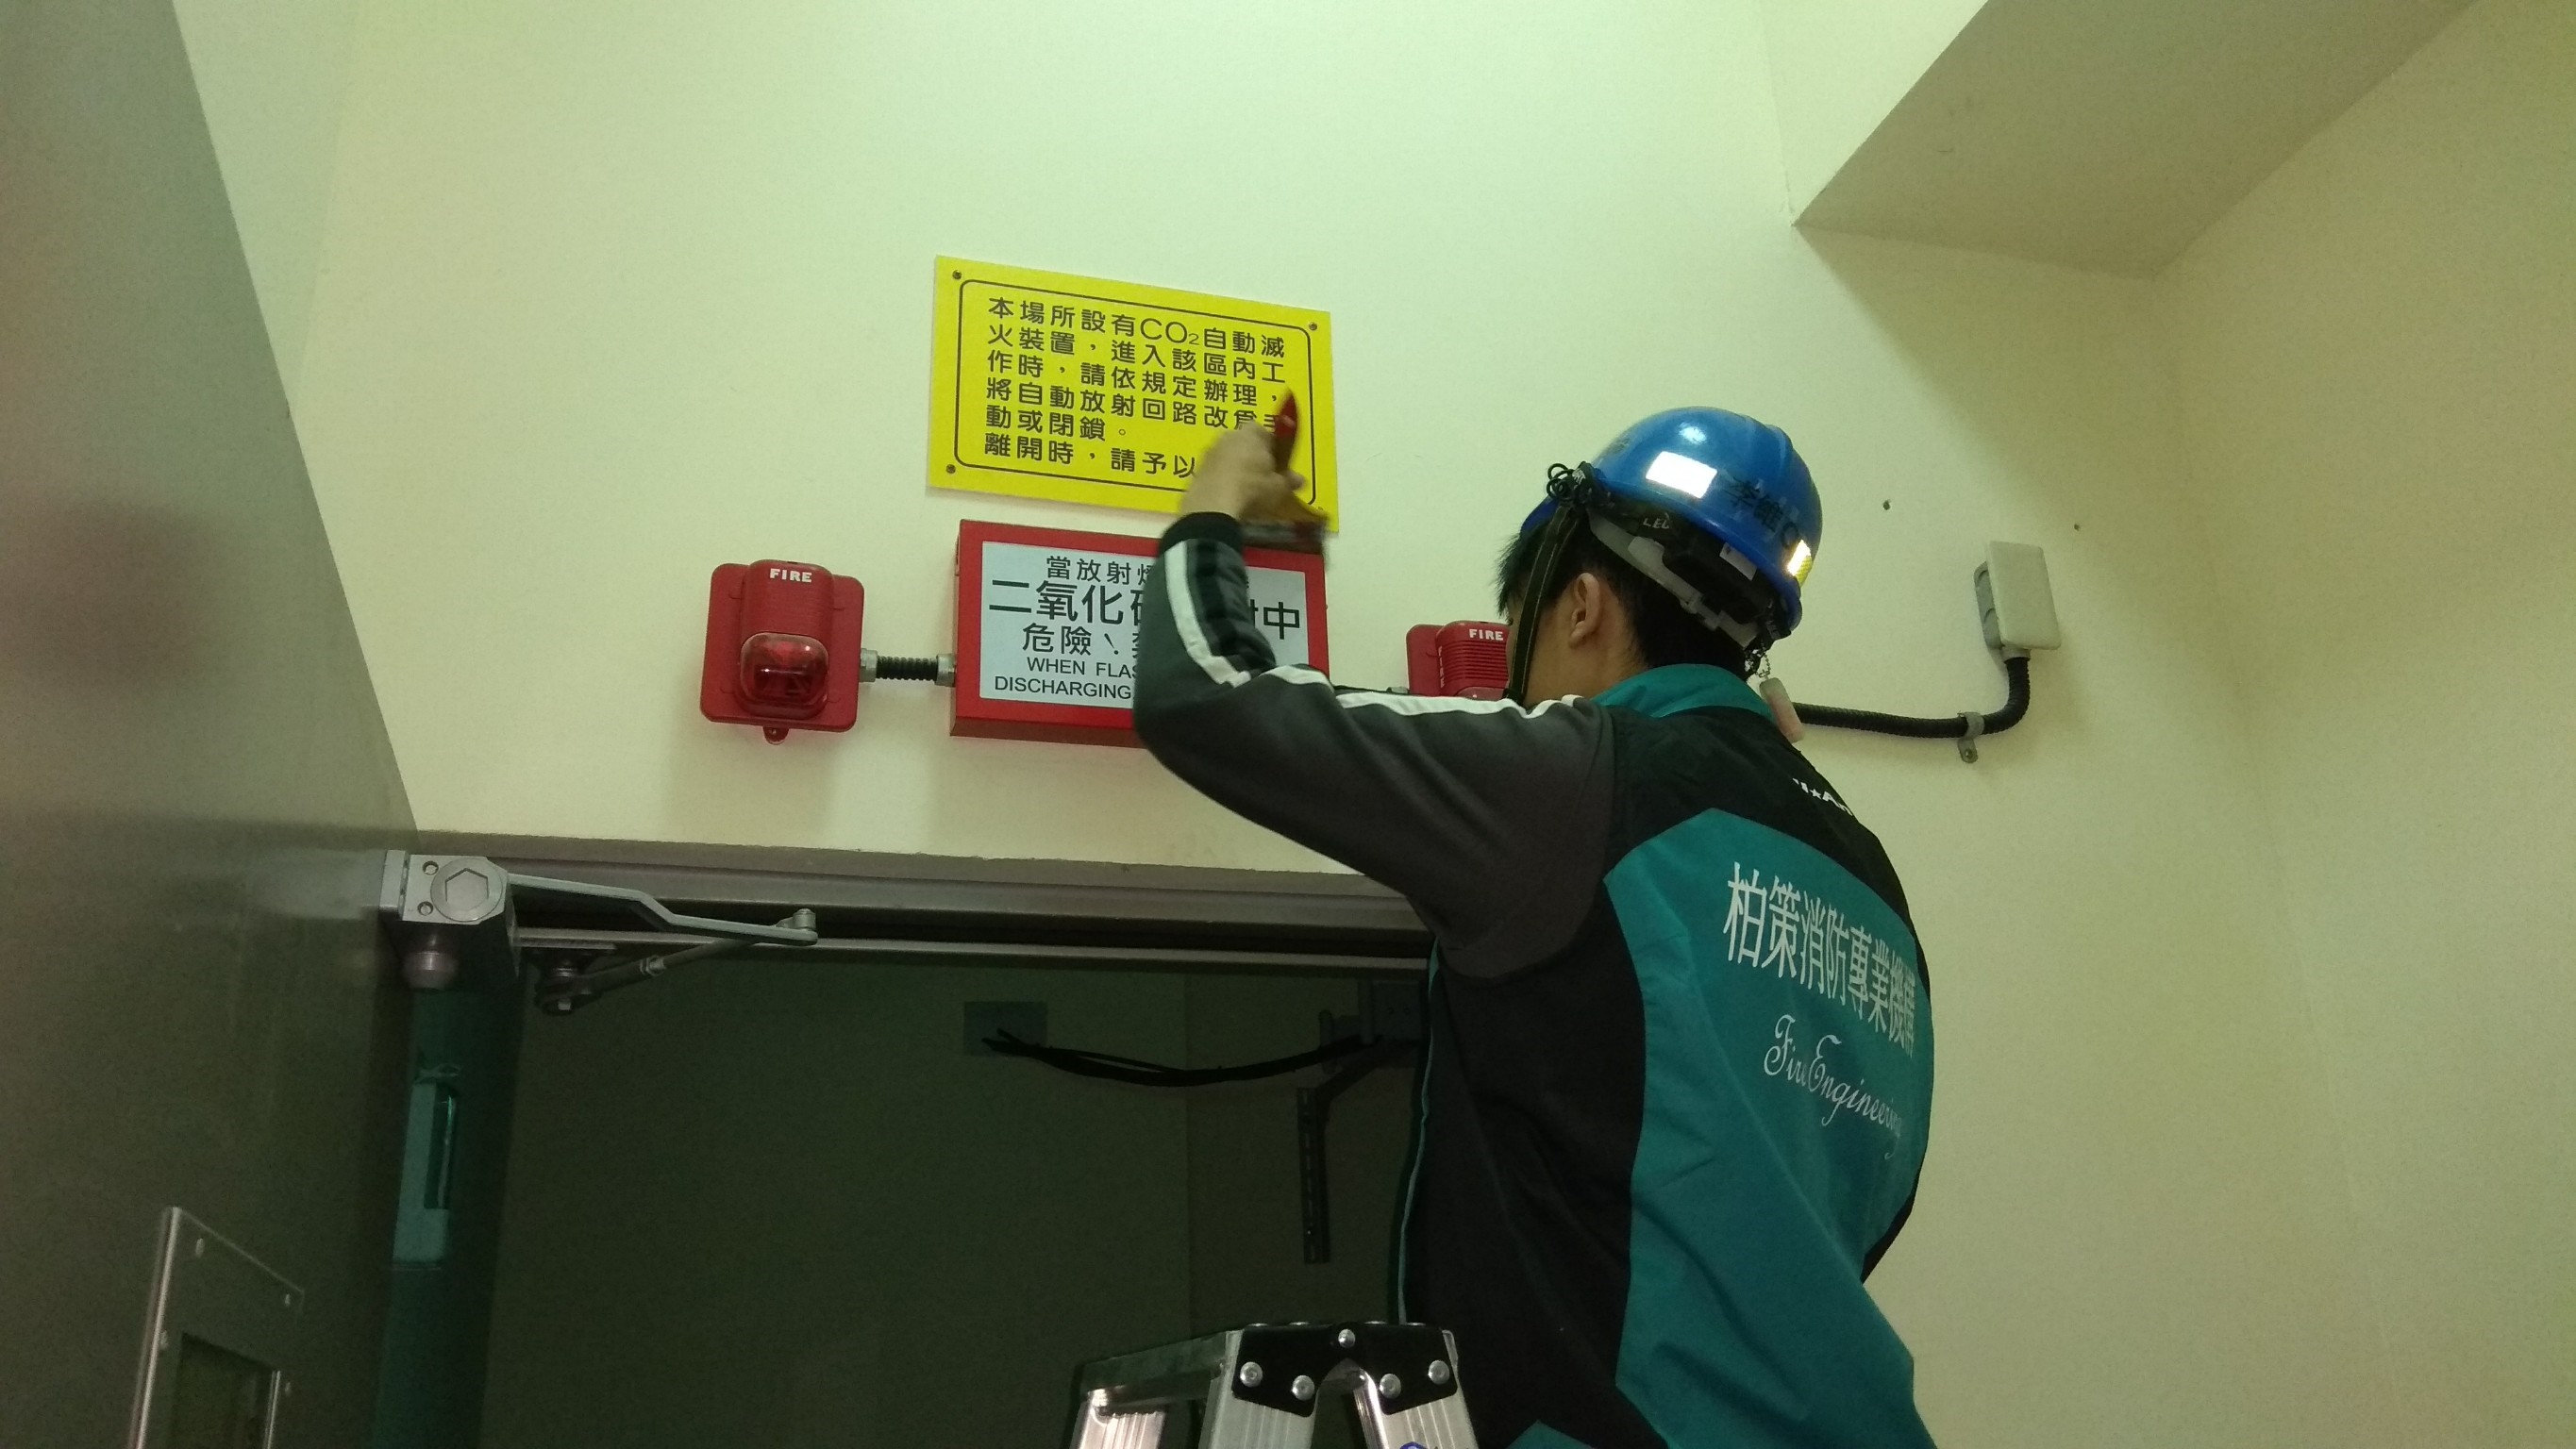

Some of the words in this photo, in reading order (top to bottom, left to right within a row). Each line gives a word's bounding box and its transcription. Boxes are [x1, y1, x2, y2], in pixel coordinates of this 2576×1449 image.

[987, 324, 1286, 385] 火裝置，進入該區內工
[768, 567, 813, 583] FIRE
[1468, 628, 1504, 641] FIRE
[1026, 656, 1086, 676] WHEN
[994, 675, 1132, 700] DISCHARGING
